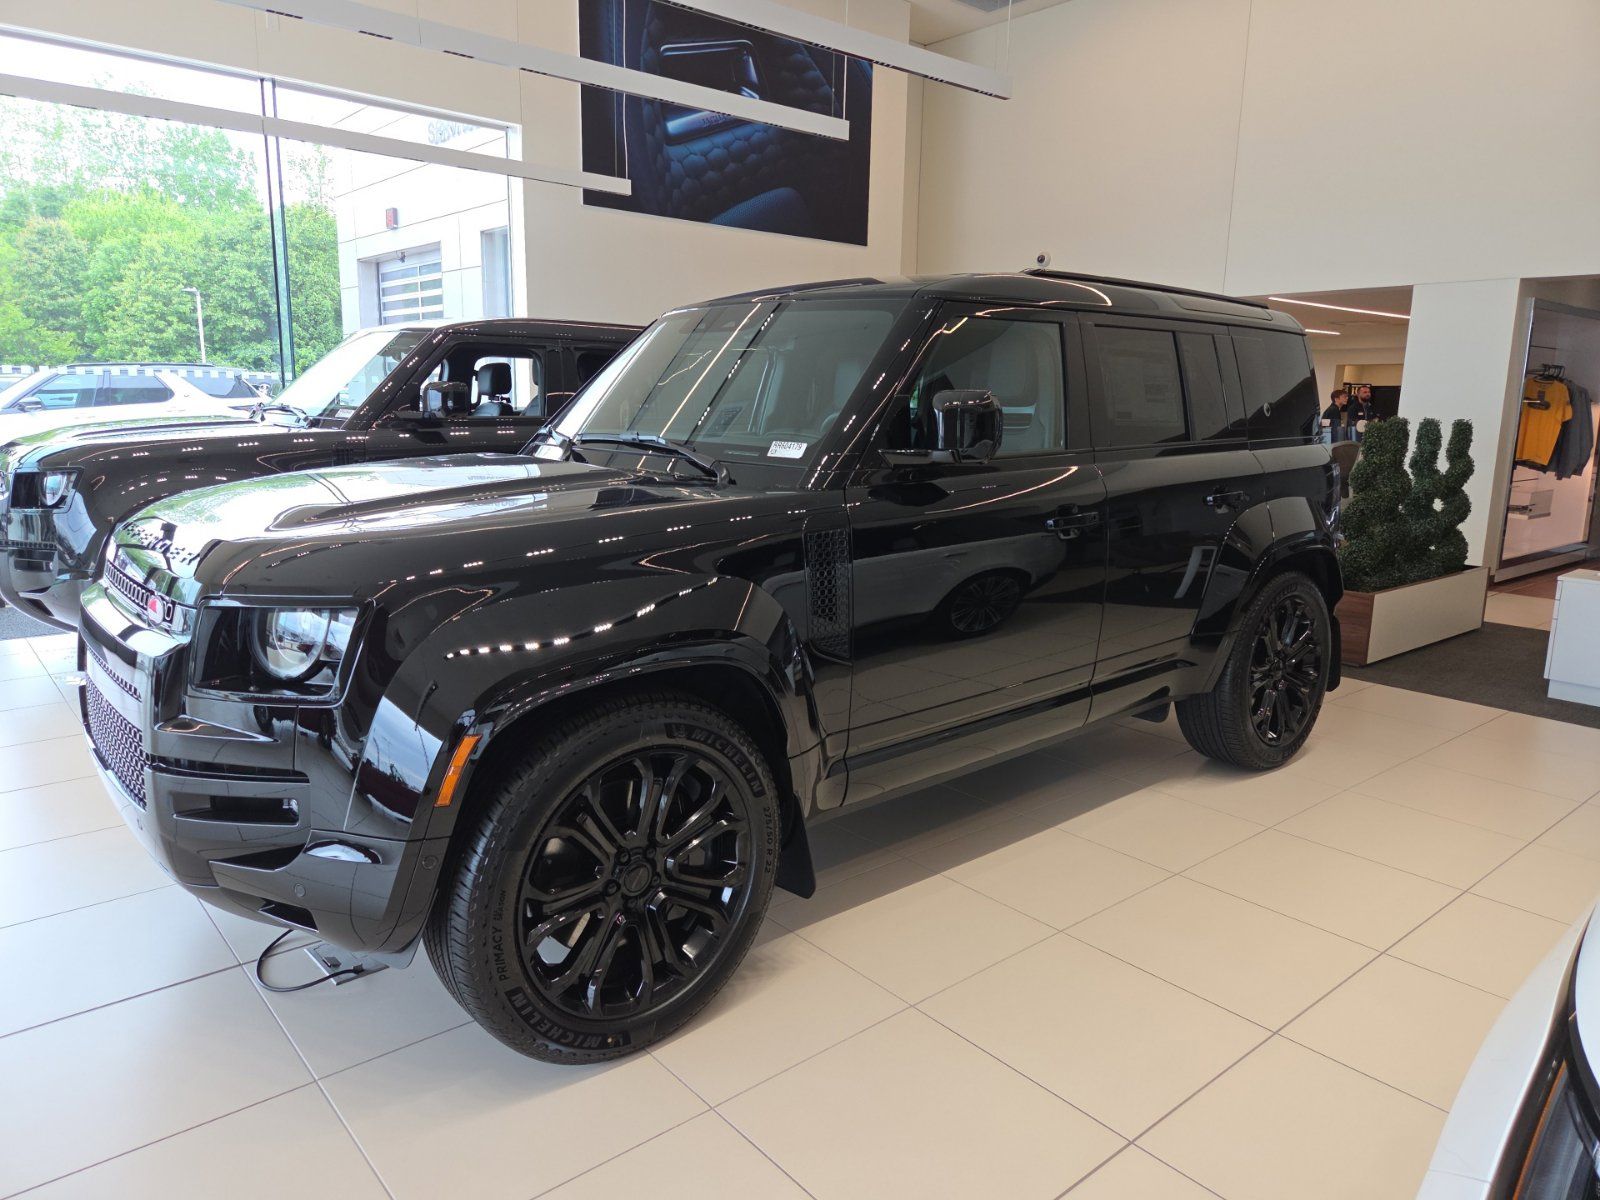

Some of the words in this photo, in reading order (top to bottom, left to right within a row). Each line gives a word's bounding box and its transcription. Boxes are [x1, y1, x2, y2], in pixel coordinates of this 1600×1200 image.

[690, 728, 764, 794] MICHELIN
[763, 806, 774, 845] 275/50
[492, 926, 509, 982] PRIMACY
[509, 991, 603, 1048] MICHELIN
